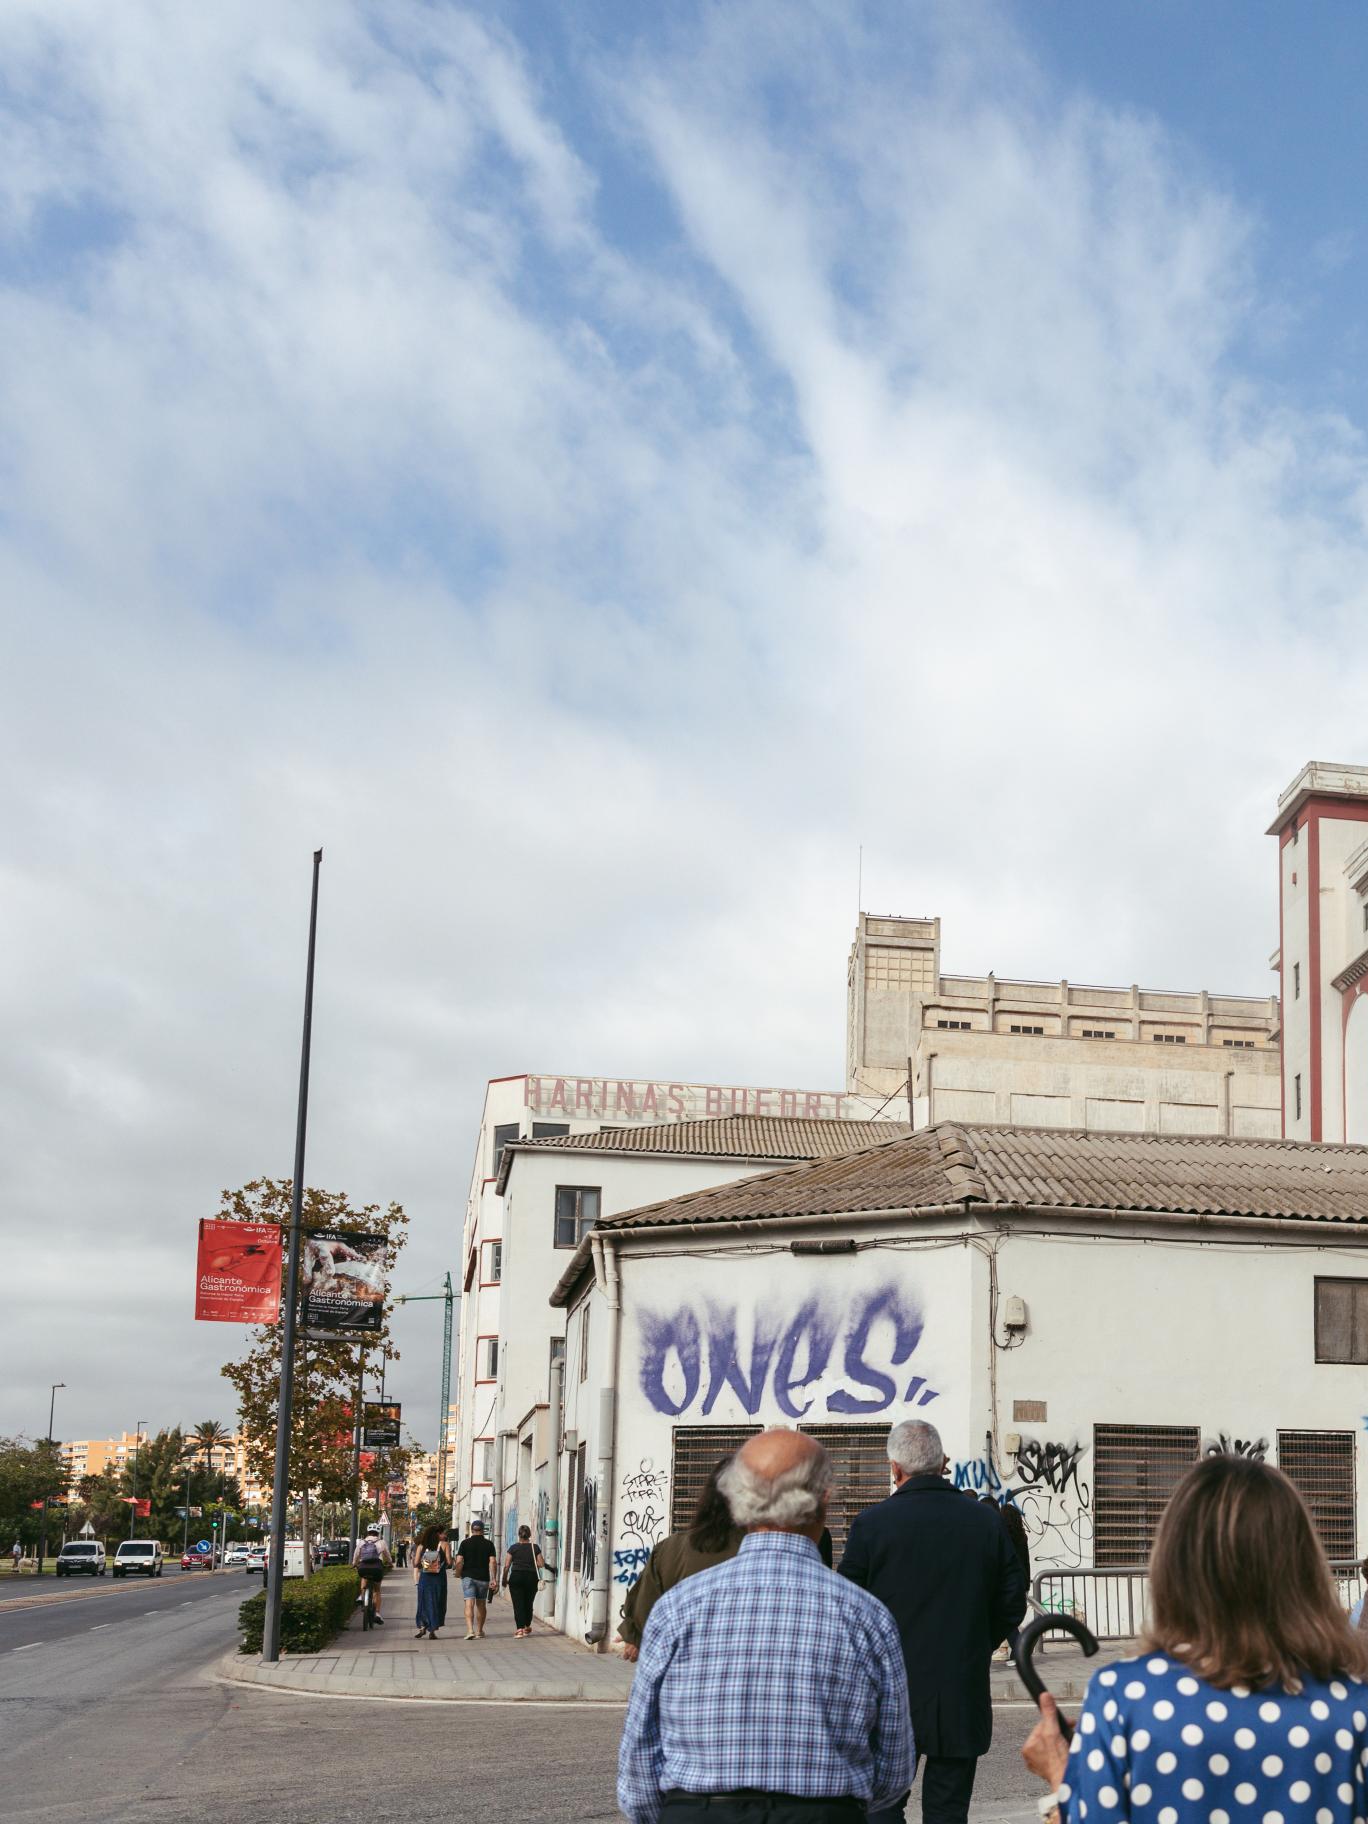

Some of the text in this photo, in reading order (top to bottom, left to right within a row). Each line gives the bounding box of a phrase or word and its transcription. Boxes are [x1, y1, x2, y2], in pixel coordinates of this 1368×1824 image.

[524, 1077, 685, 1115] HARINAS
[200, 1275, 243, 1285] Alicante
[200, 1282, 271, 1294] Gastronómica
[309, 1289, 348, 1299] Alicante
[308, 1295, 374, 1308] Gastronómica
